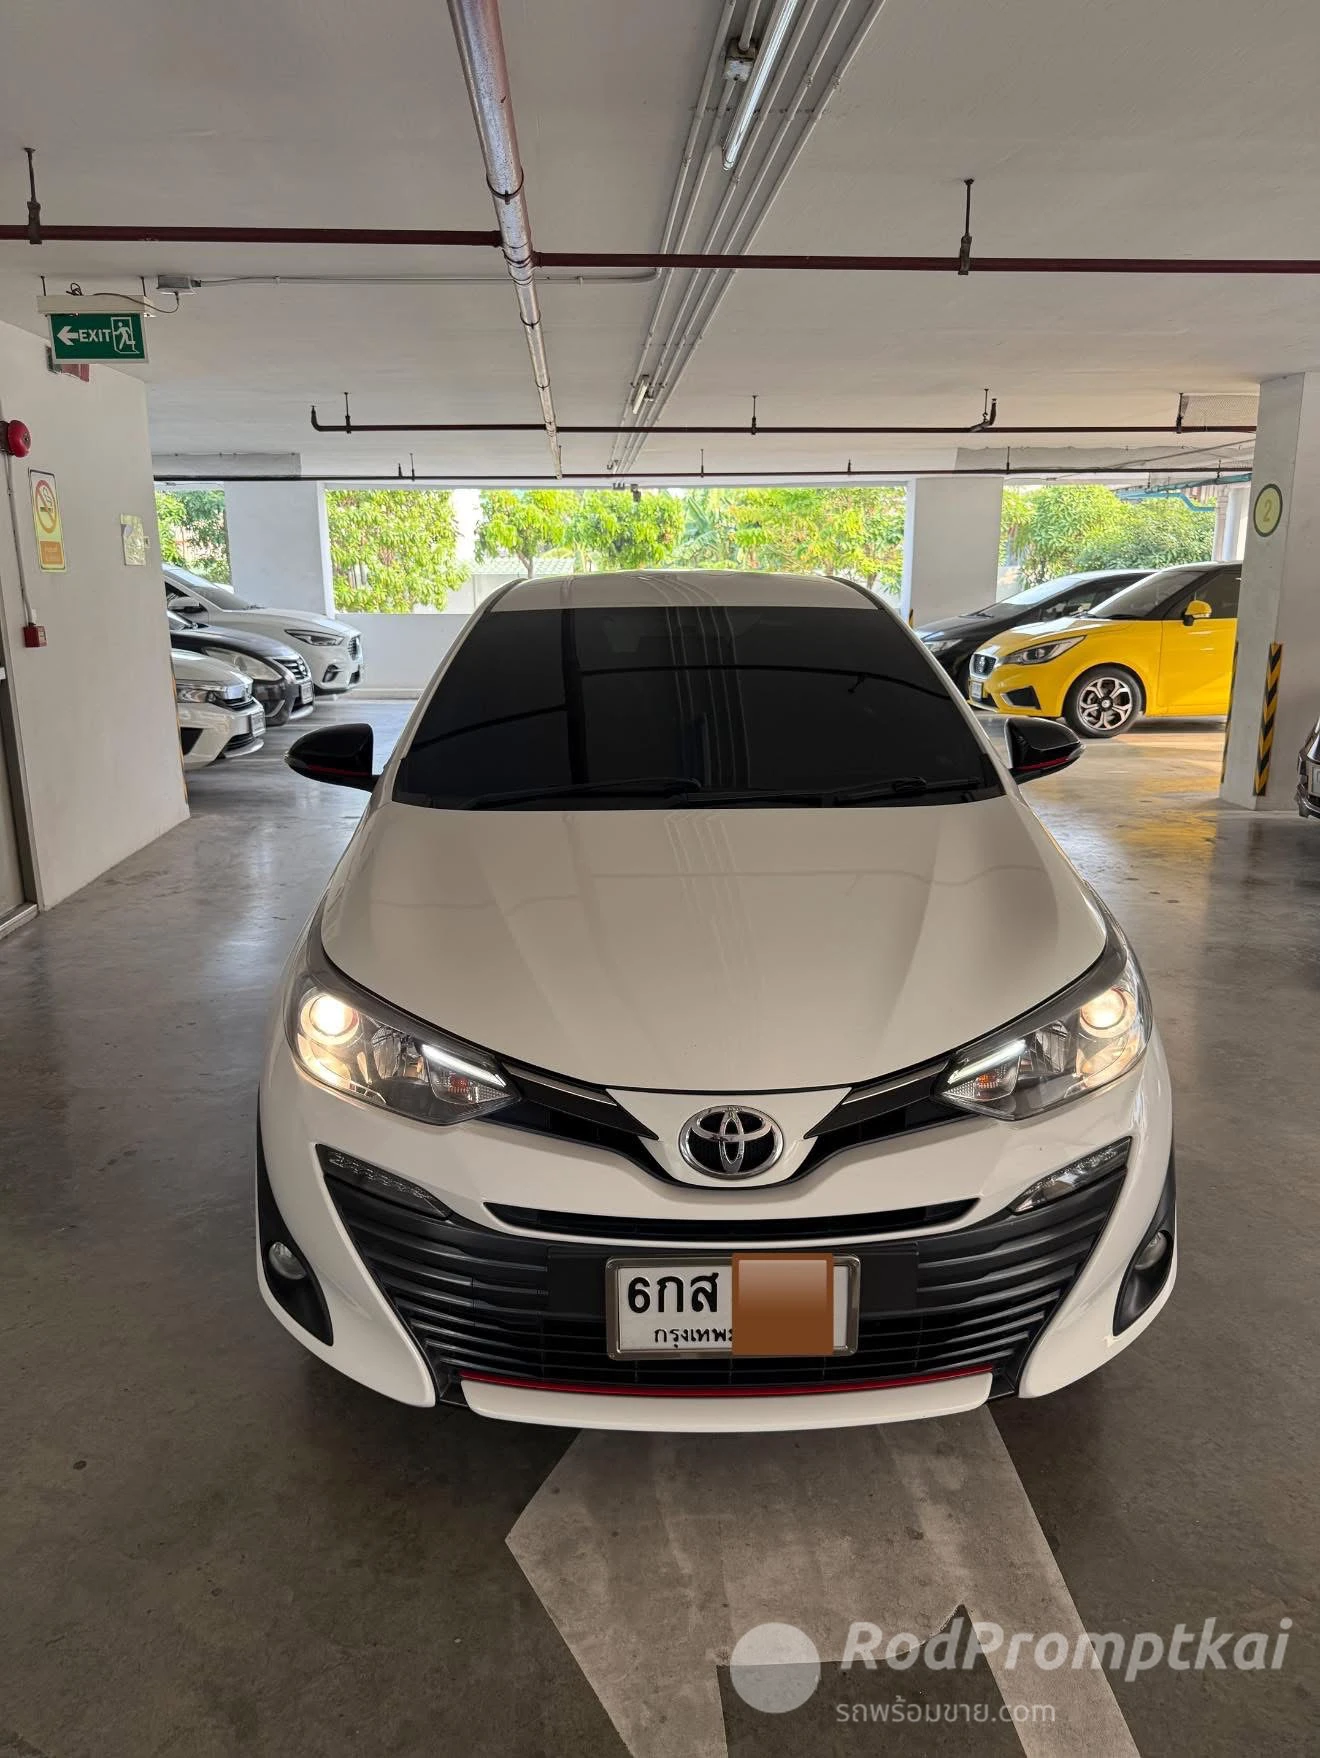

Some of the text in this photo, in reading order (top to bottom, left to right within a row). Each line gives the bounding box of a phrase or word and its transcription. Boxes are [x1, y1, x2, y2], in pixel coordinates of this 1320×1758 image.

[79, 329, 112, 342] EXIT
[1263, 499, 1273, 522] 2
[628, 1272, 719, 1313] 6กส
[654, 1328, 732, 1348] กรุงเทพ
